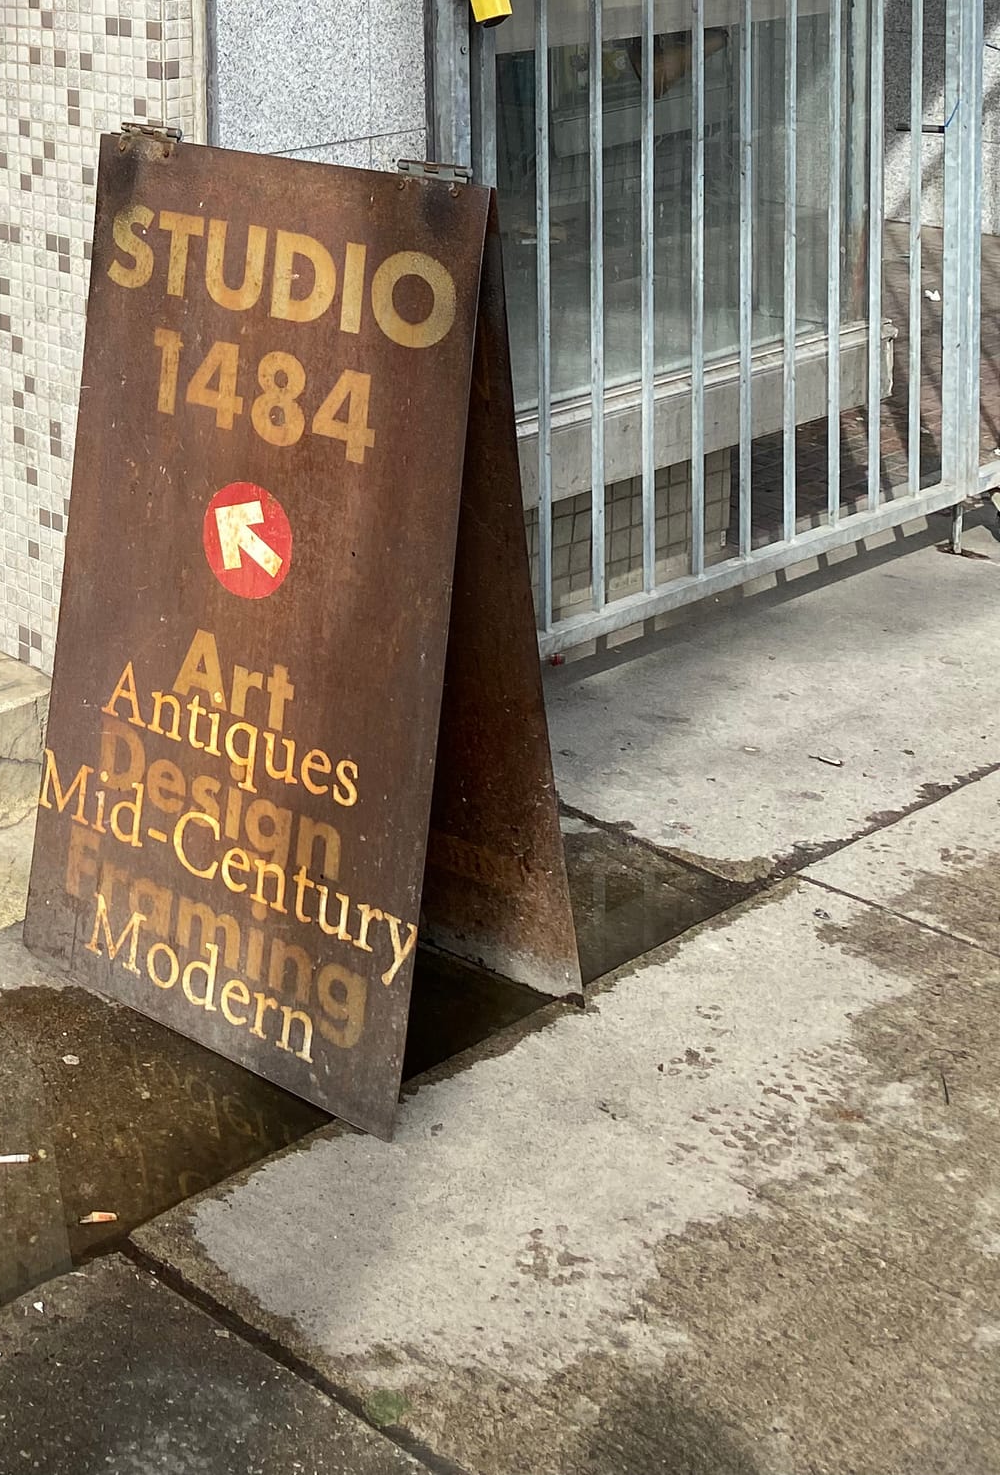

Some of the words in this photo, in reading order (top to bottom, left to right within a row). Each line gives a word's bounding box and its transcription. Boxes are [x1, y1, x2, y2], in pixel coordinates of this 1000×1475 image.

[107, 204, 456, 349] STUDIO
[154, 327, 376, 464] 1484
[101, 660, 359, 808] Antiques
[171, 628, 295, 732] Art
[38, 748, 418, 986] Mid-Century
[101, 720, 342, 882] Design
[65, 824, 369, 1050] Framing
[85, 892, 314, 1064] Modern
